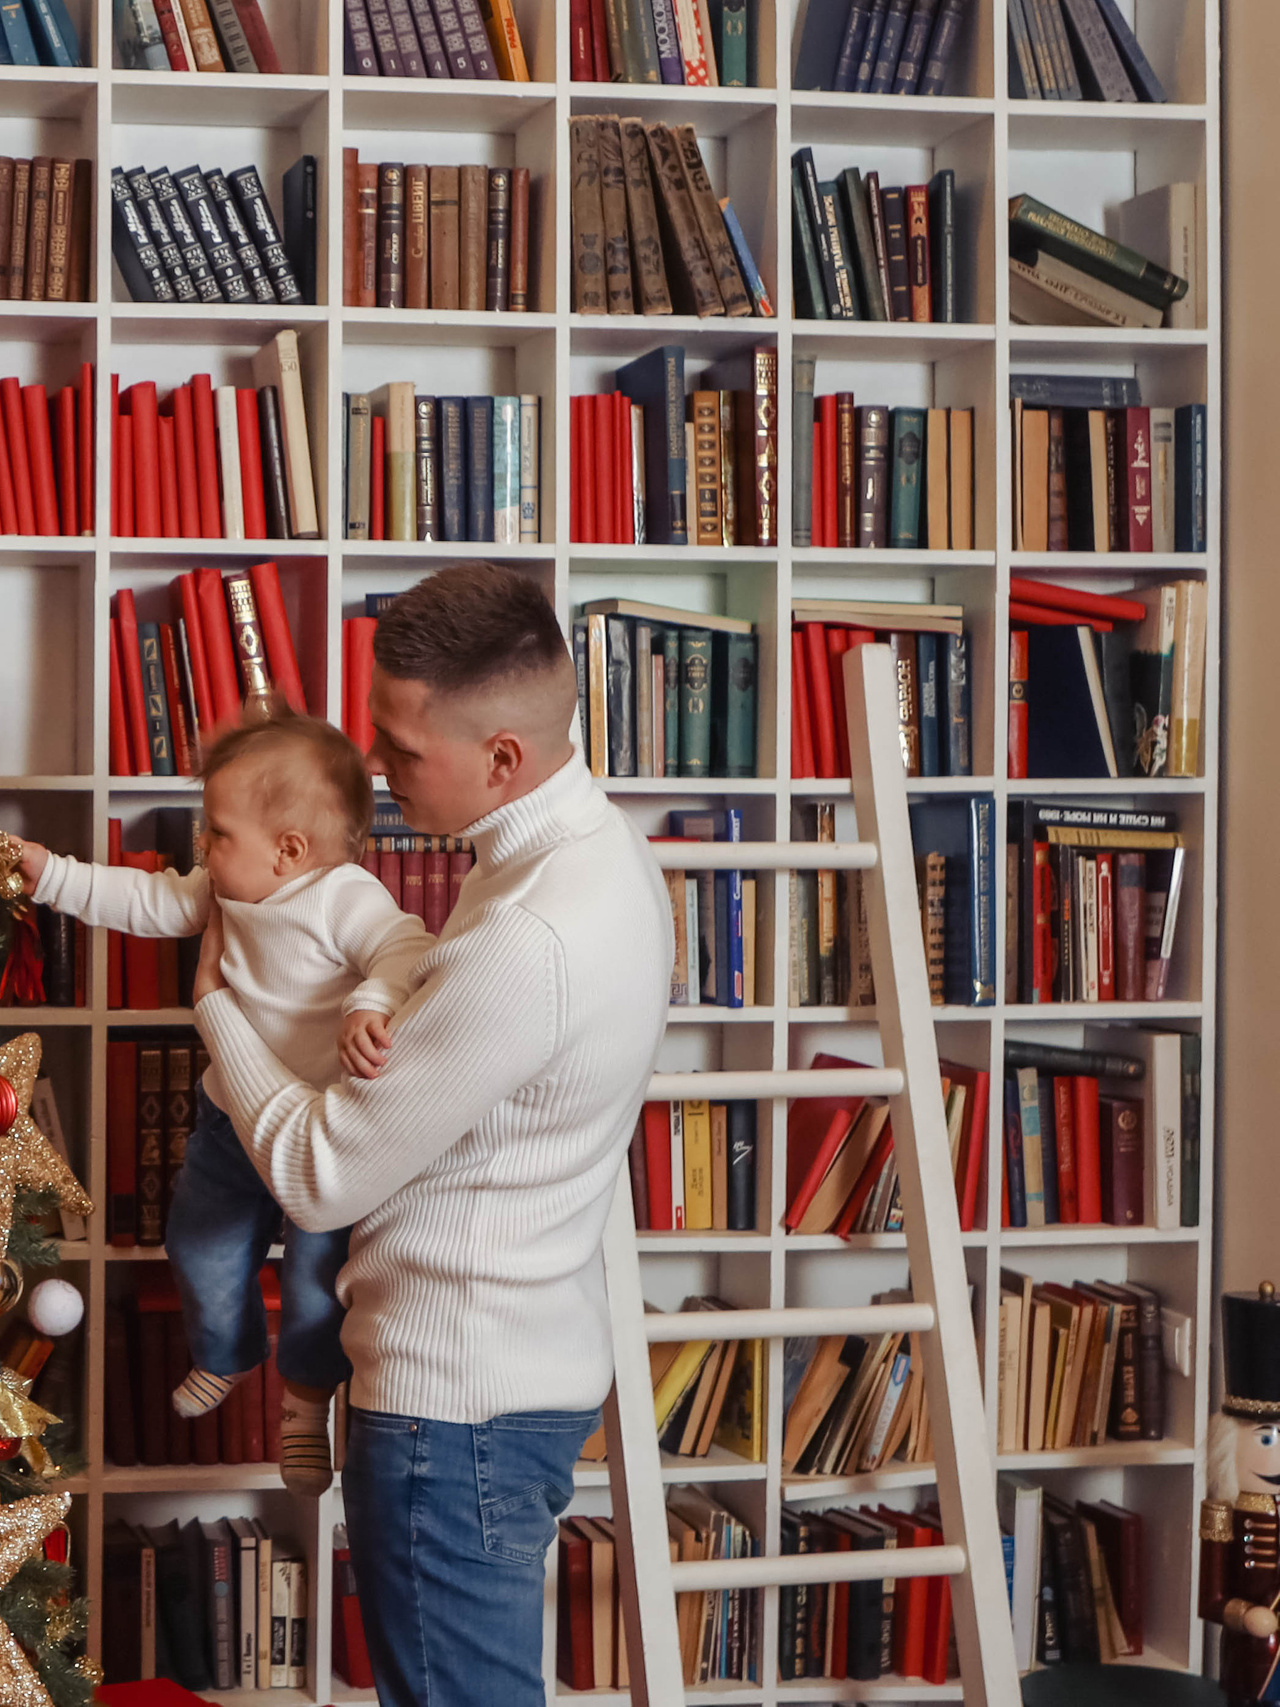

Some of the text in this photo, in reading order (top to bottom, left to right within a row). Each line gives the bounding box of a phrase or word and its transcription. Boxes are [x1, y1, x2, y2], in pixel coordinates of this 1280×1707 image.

[362, 57, 373, 68] 6
[389, 59, 397, 70] 1
[410, 59, 418, 70] 2
[434, 60, 443, 71] 4
[457, 56, 466, 68] 5
[480, 59, 489, 70] 3
[391, 232, 400, 264] СТОКЕР
[894, 658, 914, 721] ФАРАОН
[1118, 813, 1149, 825] СУШЕ
